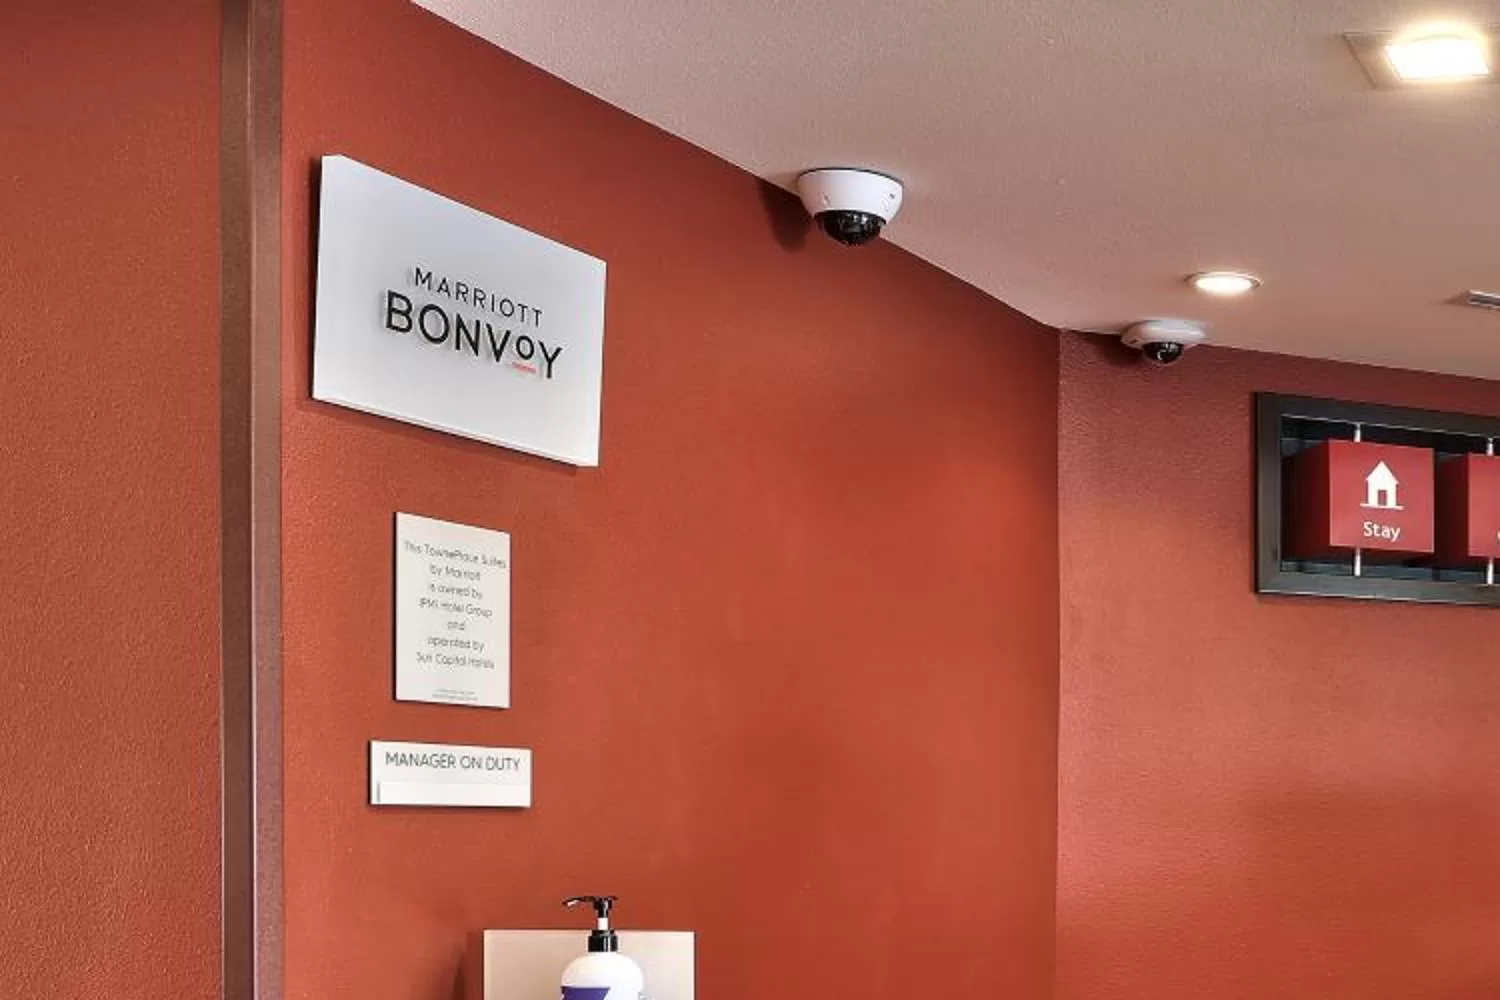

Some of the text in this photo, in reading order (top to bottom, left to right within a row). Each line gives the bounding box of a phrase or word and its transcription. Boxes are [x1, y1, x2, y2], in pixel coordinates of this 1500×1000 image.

[414, 267, 544, 329] MARRIOTT
[385, 290, 562, 379] BONVOY
[1363, 521, 1401, 542] Stay
[385, 751, 521, 771] MANAGER ON DUTY
